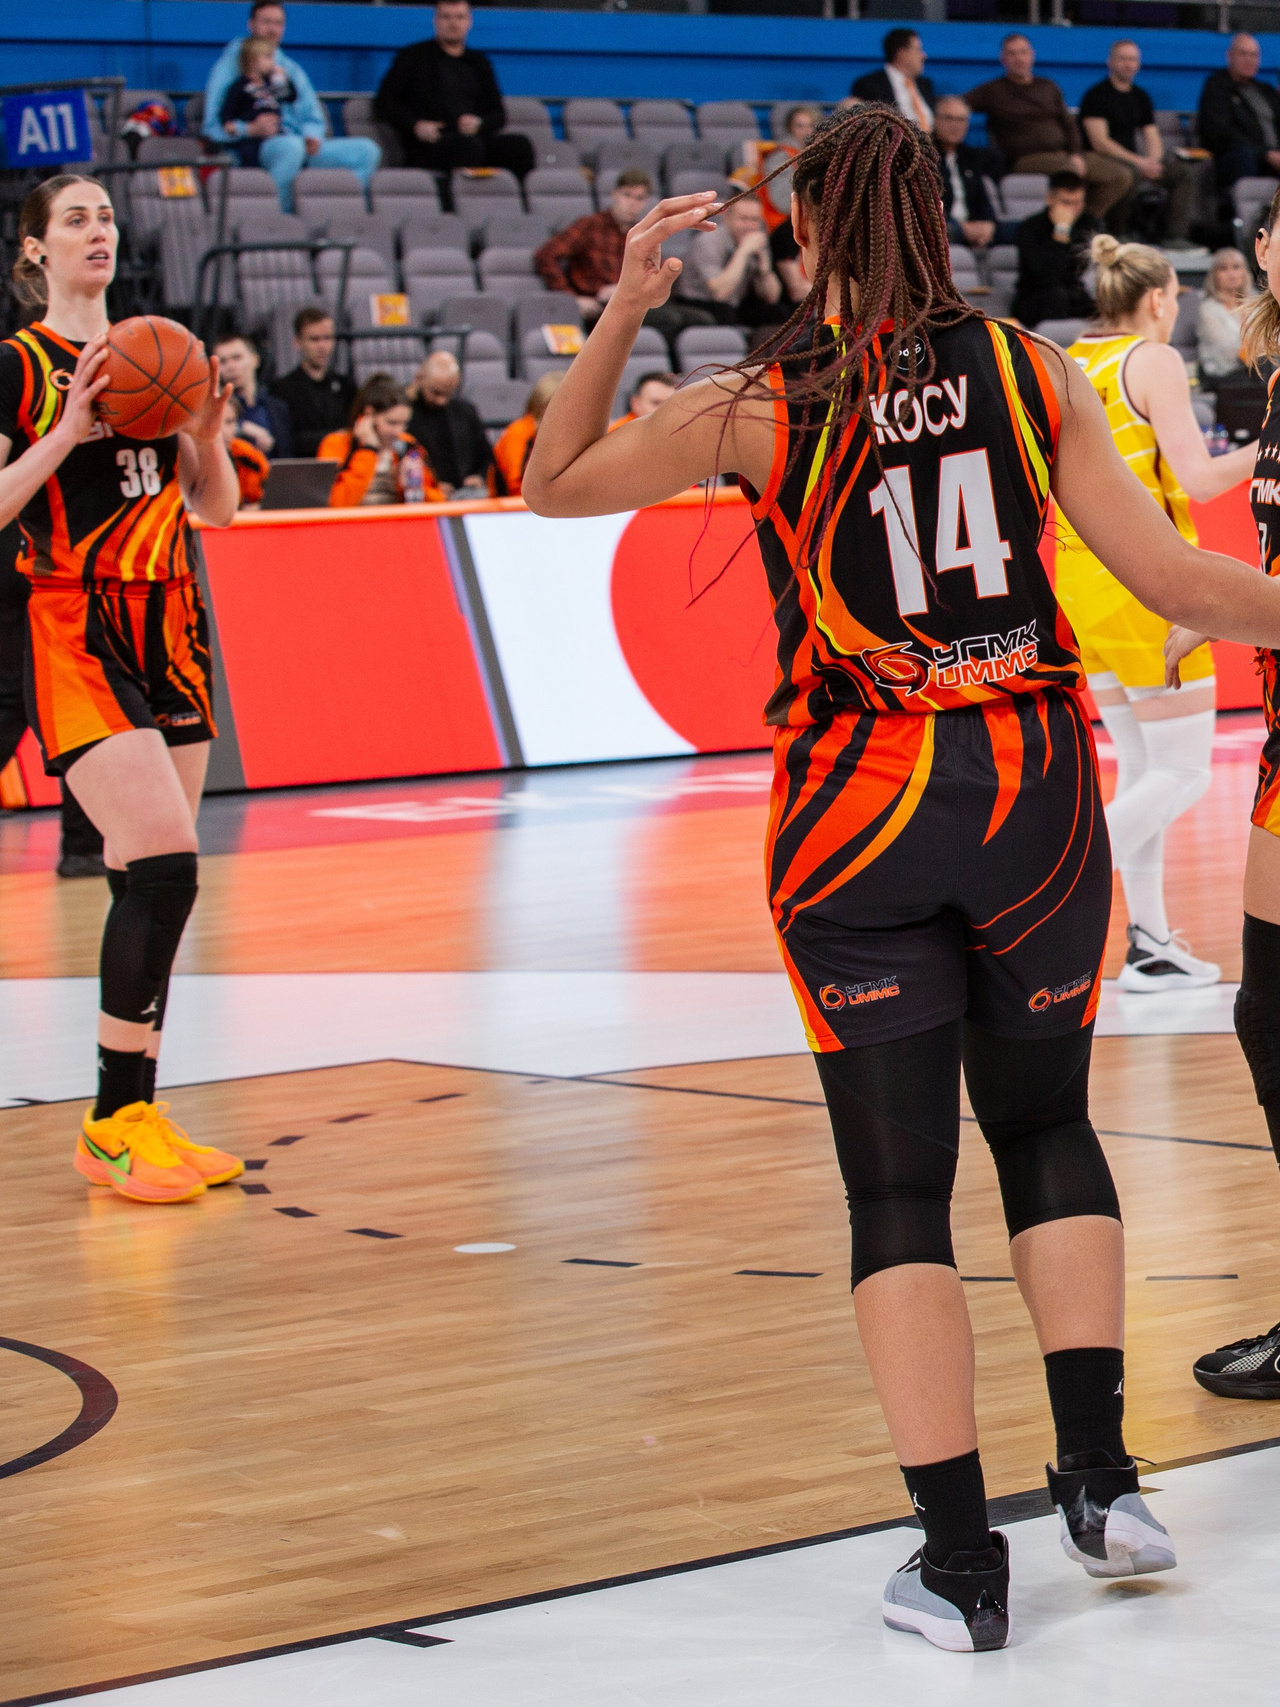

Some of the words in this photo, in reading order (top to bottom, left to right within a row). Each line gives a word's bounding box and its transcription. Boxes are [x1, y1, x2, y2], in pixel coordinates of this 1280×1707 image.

[18, 103, 77, 155] A11
[868, 375, 967, 445] КОСУ
[116, 447, 161, 498] 38
[868, 448, 1012, 617] 14
[932, 619, 1040, 671] УГМК
[936, 643, 1038, 689] UMMC
[845, 976, 899, 996] УГМК
[848, 985, 900, 1005] UMMC
